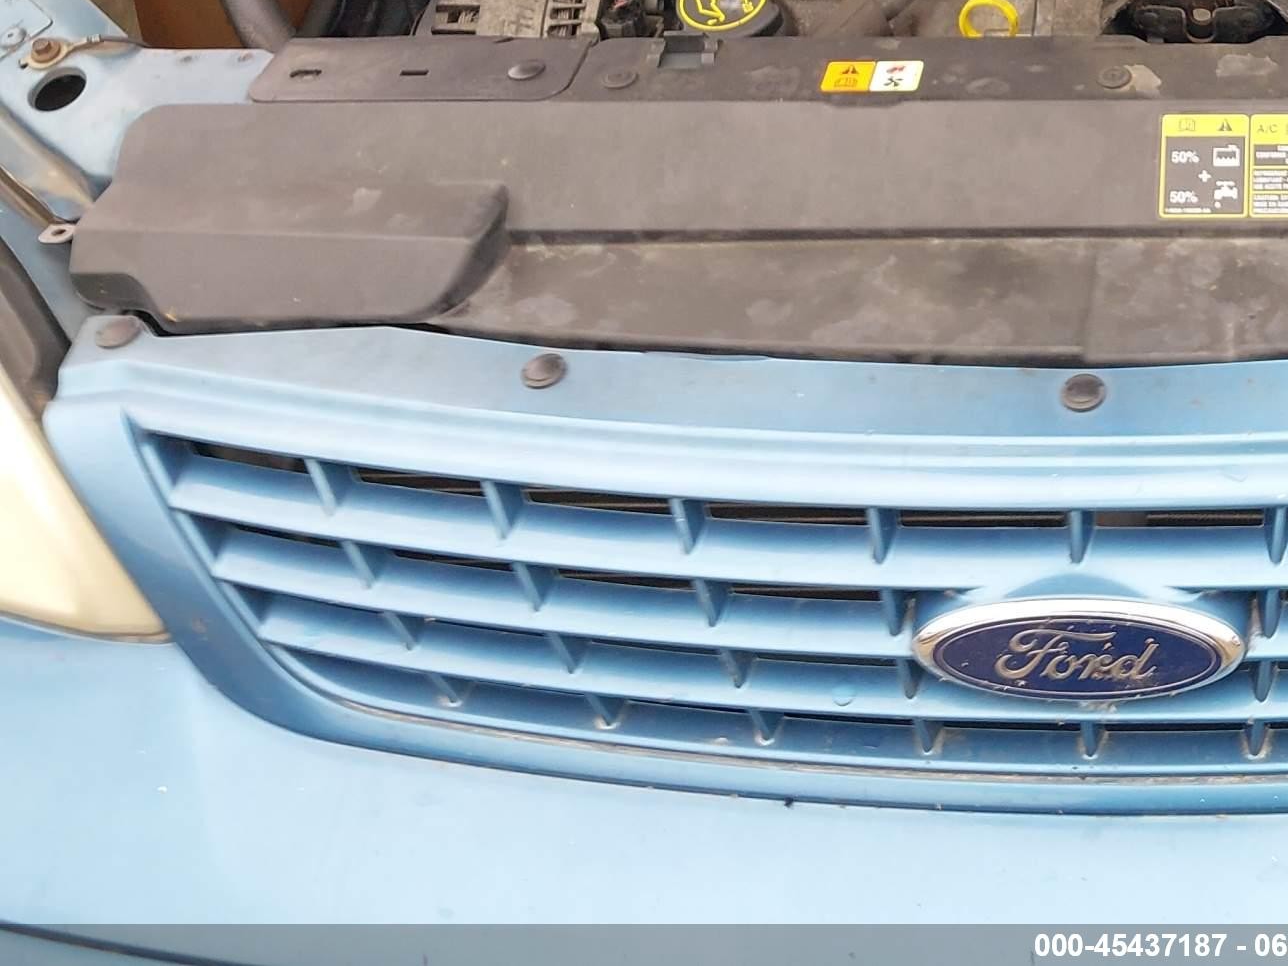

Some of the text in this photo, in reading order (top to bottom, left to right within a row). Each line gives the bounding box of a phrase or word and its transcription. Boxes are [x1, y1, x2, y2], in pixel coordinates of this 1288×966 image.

[1170, 150, 1200, 164] 50%
[1169, 190, 1199, 204] 50%
[993, 628, 1160, 682] Ford
